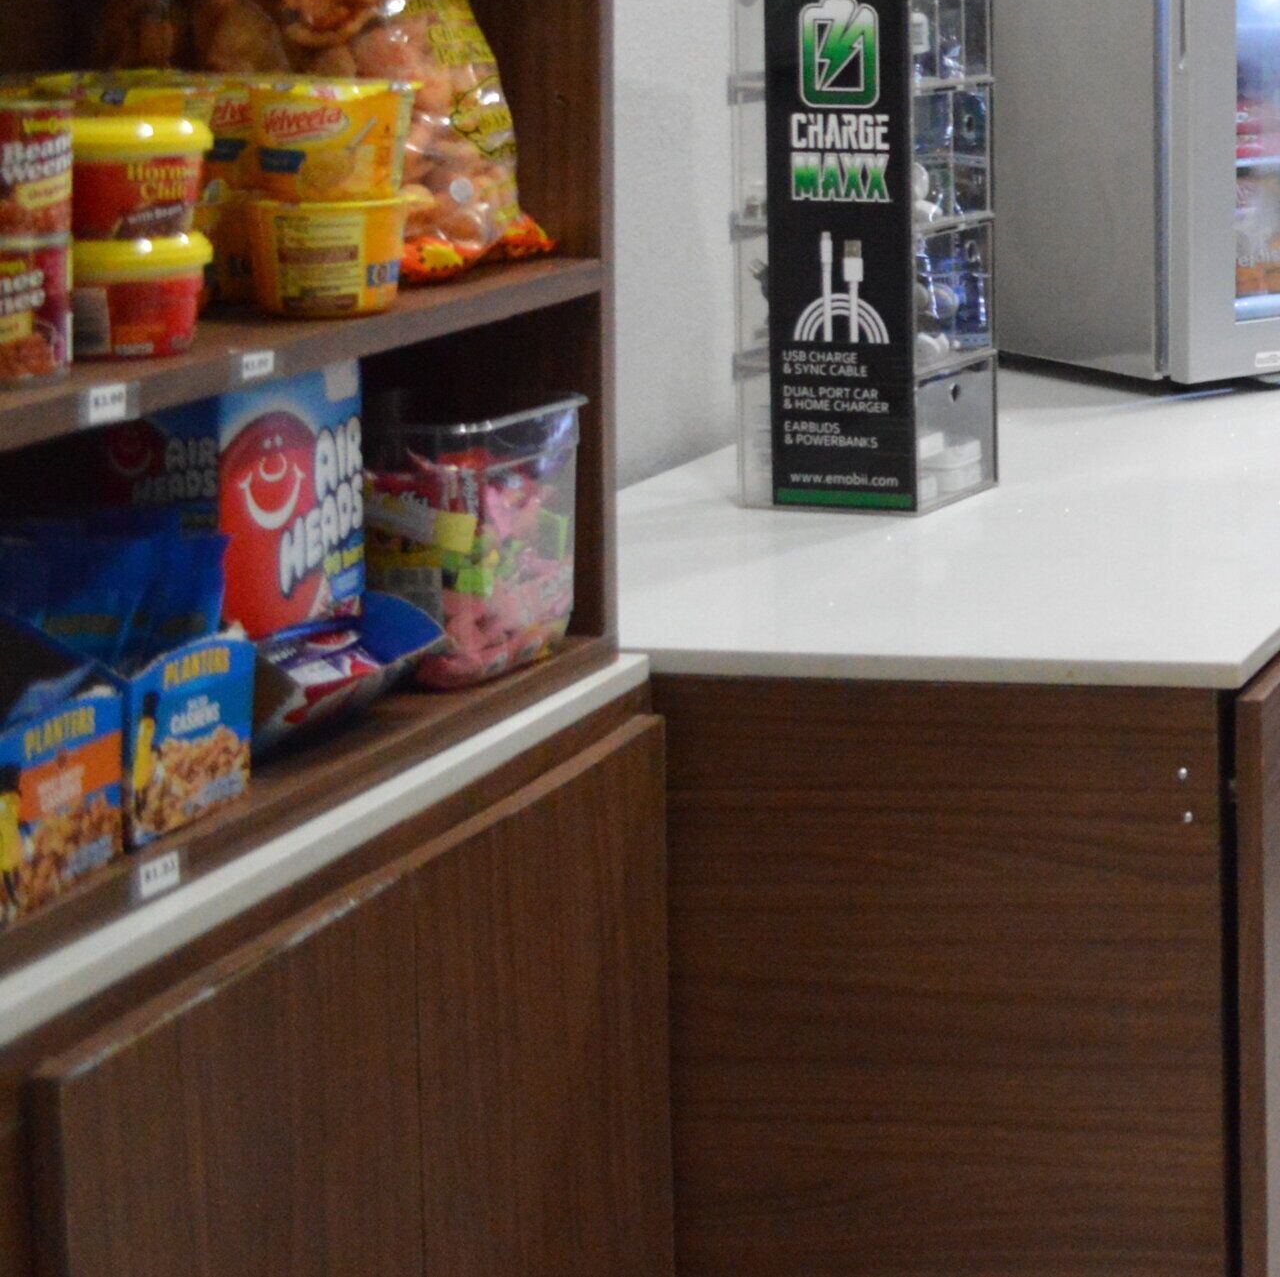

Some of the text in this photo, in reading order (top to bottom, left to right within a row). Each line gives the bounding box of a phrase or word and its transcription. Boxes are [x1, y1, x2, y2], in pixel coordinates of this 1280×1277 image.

[790, 113, 891, 150] CHARGE
[790, 152, 892, 203] MAXX
[782, 350, 859, 365] USB CHARGE
[782, 363, 868, 378] & SYNC CABLE
[782, 384, 879, 401] DUAL PORT CAR
[782, 398, 890, 414] & HOME CHARGER
[783, 420, 841, 435] EARBUDS
[784, 433, 879, 449] & POWERBANKS
[315, 416, 363, 502] AIR
[279, 472, 364, 600] HEADS
